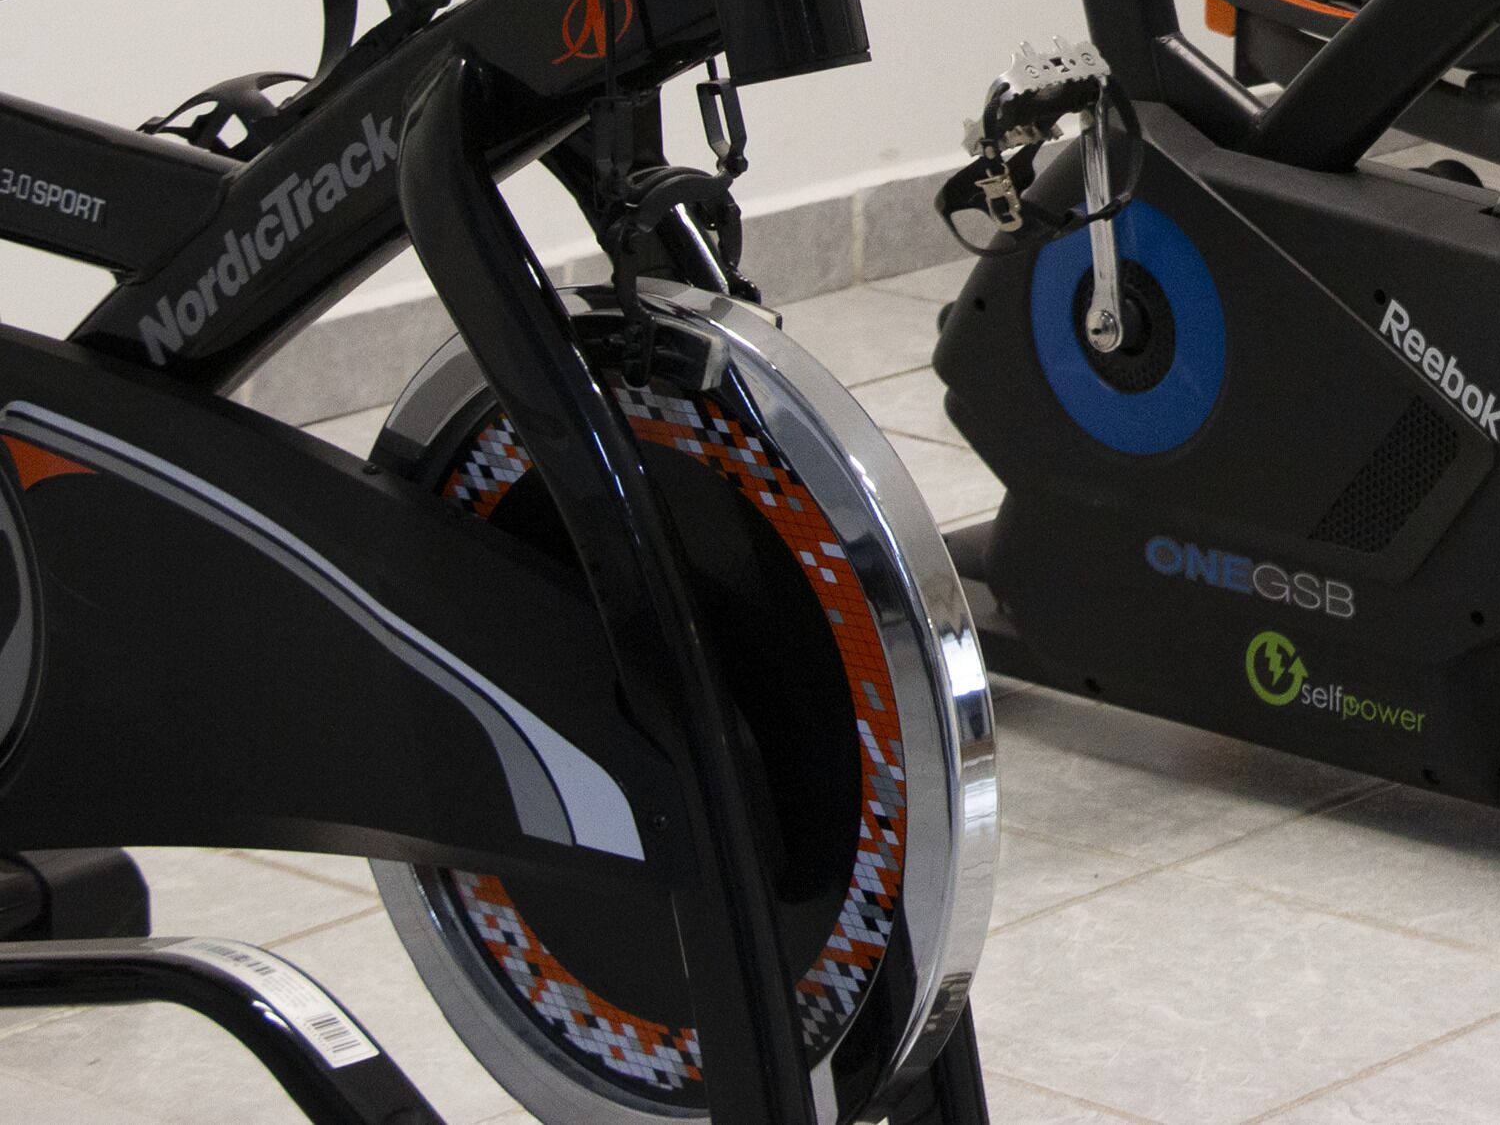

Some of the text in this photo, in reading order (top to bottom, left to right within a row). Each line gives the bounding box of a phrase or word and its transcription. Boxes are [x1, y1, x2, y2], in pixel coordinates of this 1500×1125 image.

[31, 180, 107, 223] SPORT
[139, 112, 398, 366] NordicTrack
[1301, 684, 1427, 734] selfpower
